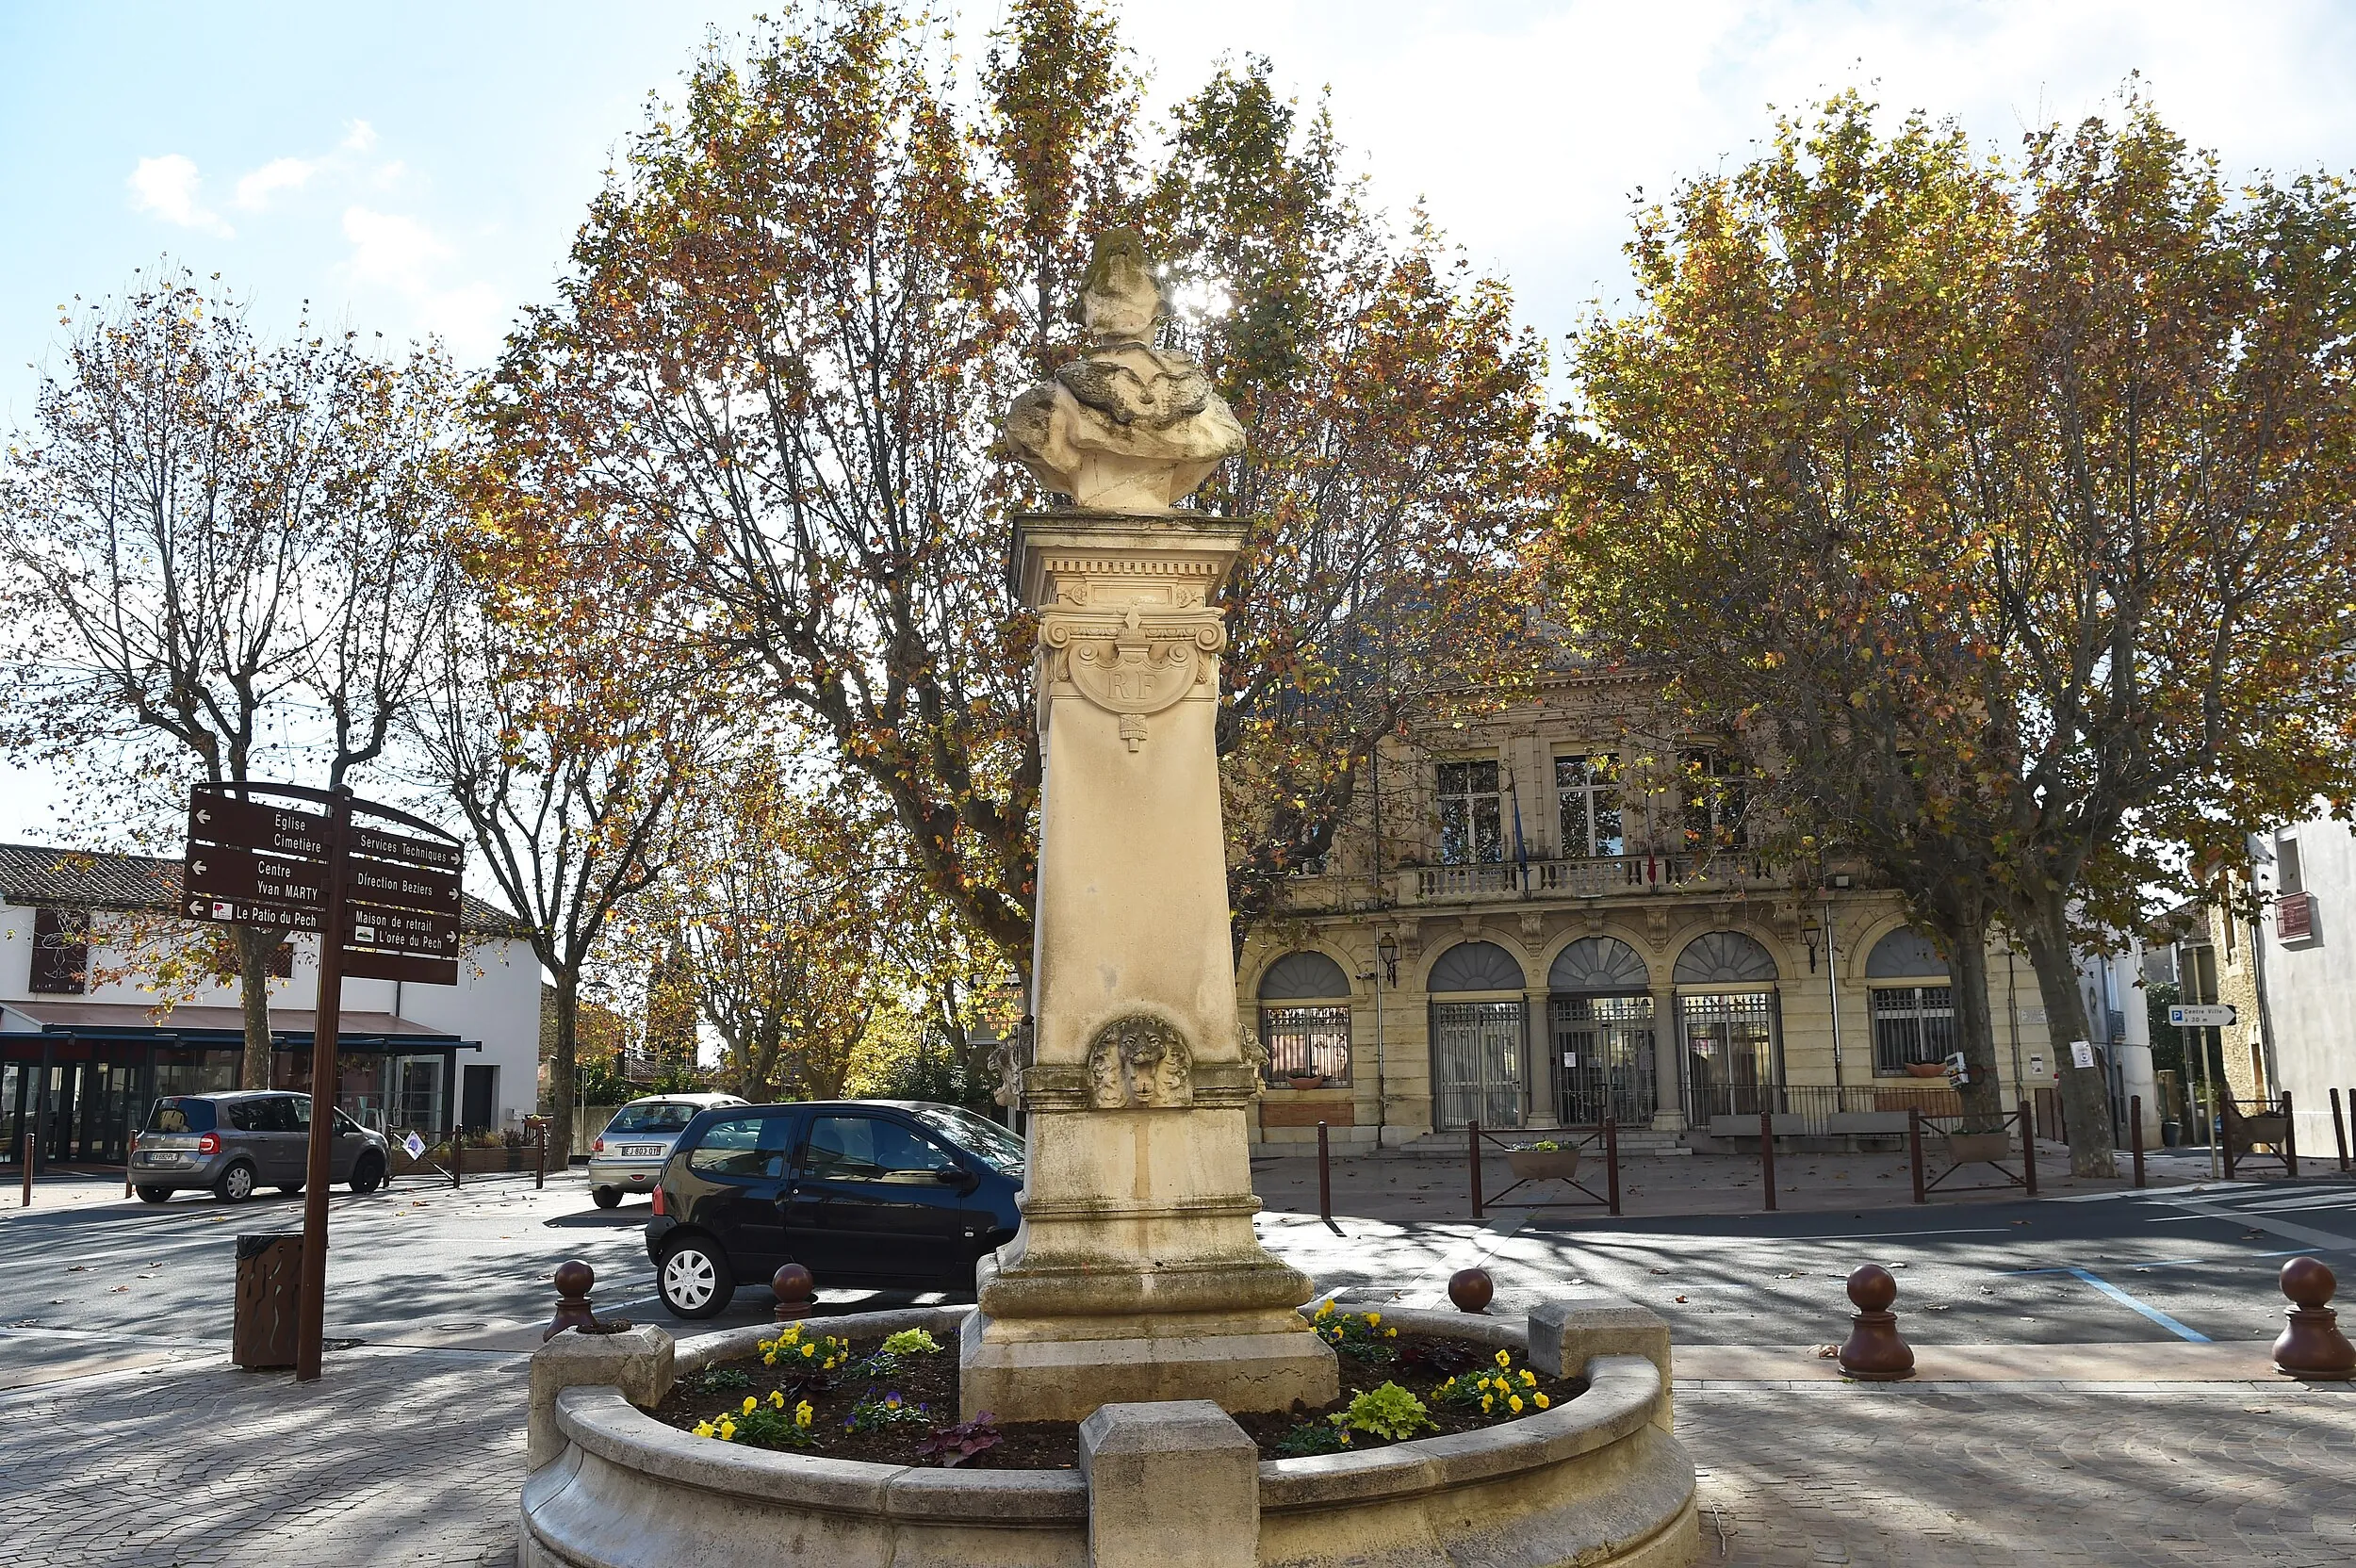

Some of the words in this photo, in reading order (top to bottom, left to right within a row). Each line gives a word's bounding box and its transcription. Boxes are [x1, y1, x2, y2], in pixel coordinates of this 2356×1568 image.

[275, 810, 306, 831] Église
[274, 833, 321, 853] Cimetière
[360, 834, 397, 853] Services
[402, 842, 447, 862] Techniques
[257, 860, 291, 878] Centre
[257, 880, 280, 896] Yvan
[285, 884, 319, 901] MARTY
[402, 879, 433, 896] Beziers
[237, 906, 248, 920] Le
[252, 906, 276, 923] Patio
[280, 911, 291, 924] du
[294, 912, 317, 927] Pech
[355, 910, 386, 926] Maison
[391, 915, 401, 928] de
[405, 918, 432, 932] retrait
[379, 930, 405, 945] L'orée
[409, 934, 419, 947] du
[422, 936, 442, 949] Pech
